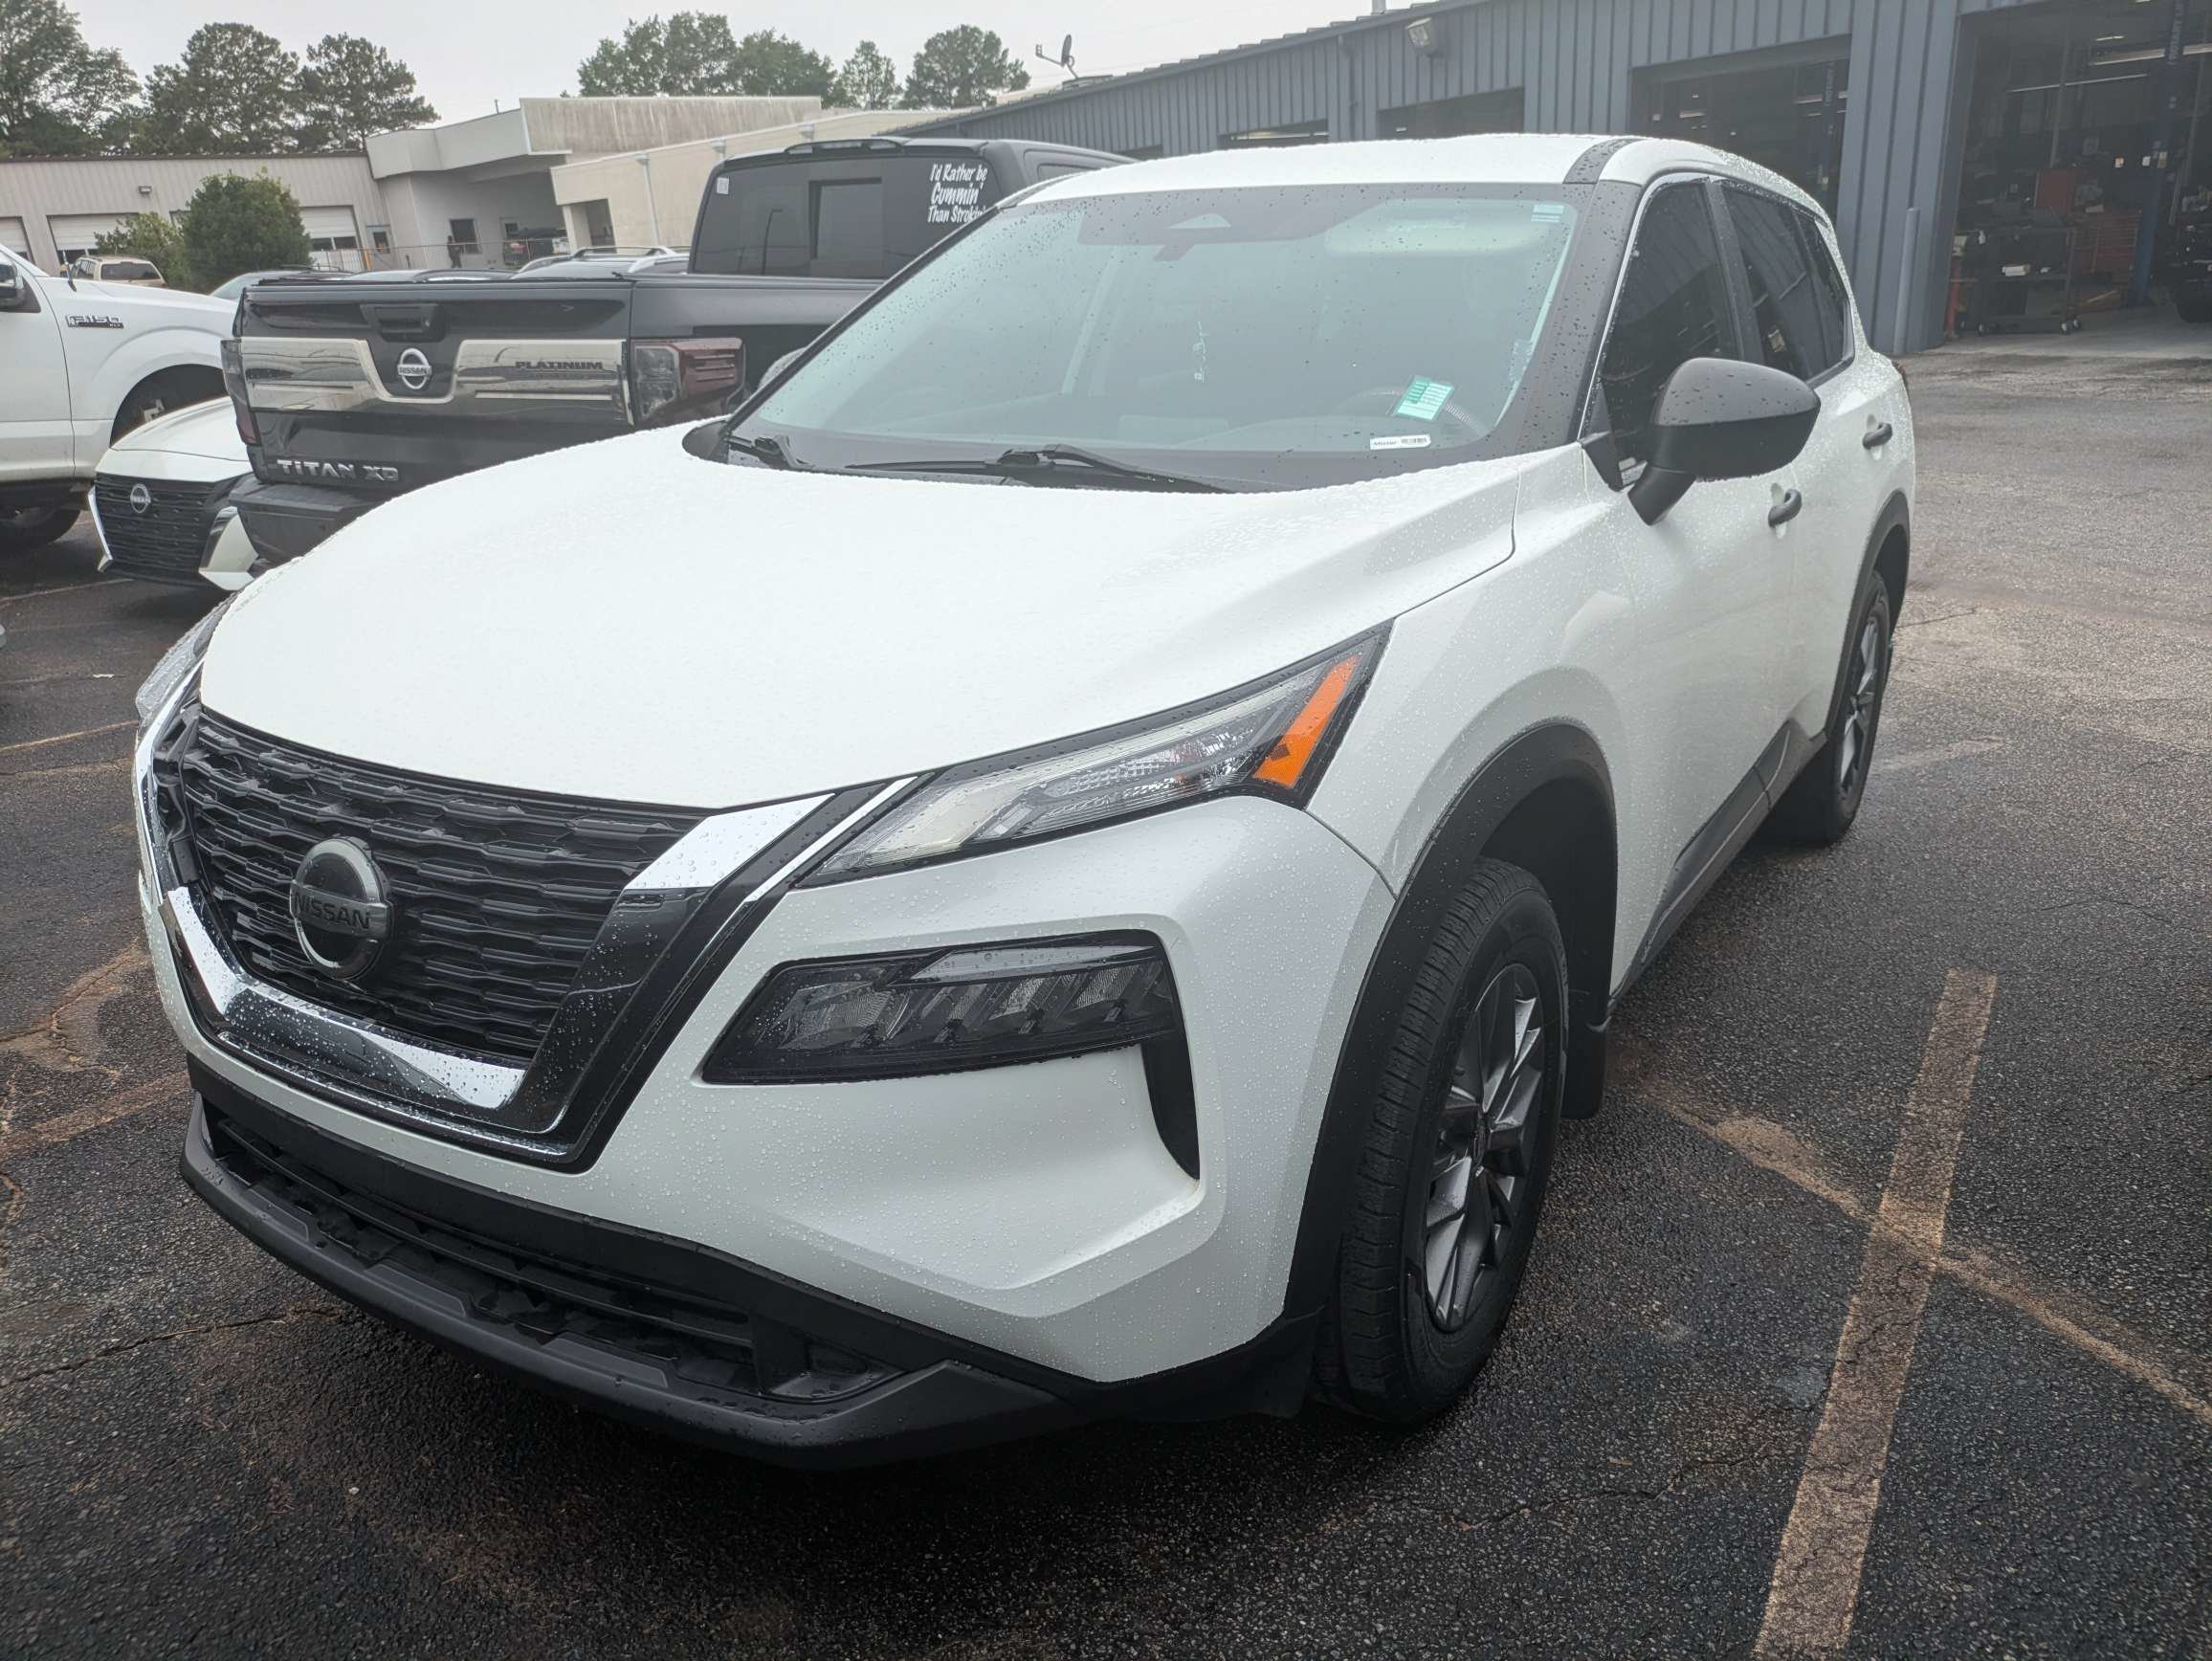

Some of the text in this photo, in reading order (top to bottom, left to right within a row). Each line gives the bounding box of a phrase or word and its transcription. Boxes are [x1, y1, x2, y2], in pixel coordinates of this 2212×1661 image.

[930, 164, 988, 182] I'd Rather be
[931, 182, 984, 205] Cummin'
[927, 206, 950, 223] Than
[515, 361, 604, 370] PLATINUM
[276, 459, 399, 481] TITAN XD
[294, 892, 371, 930] NISSAN
